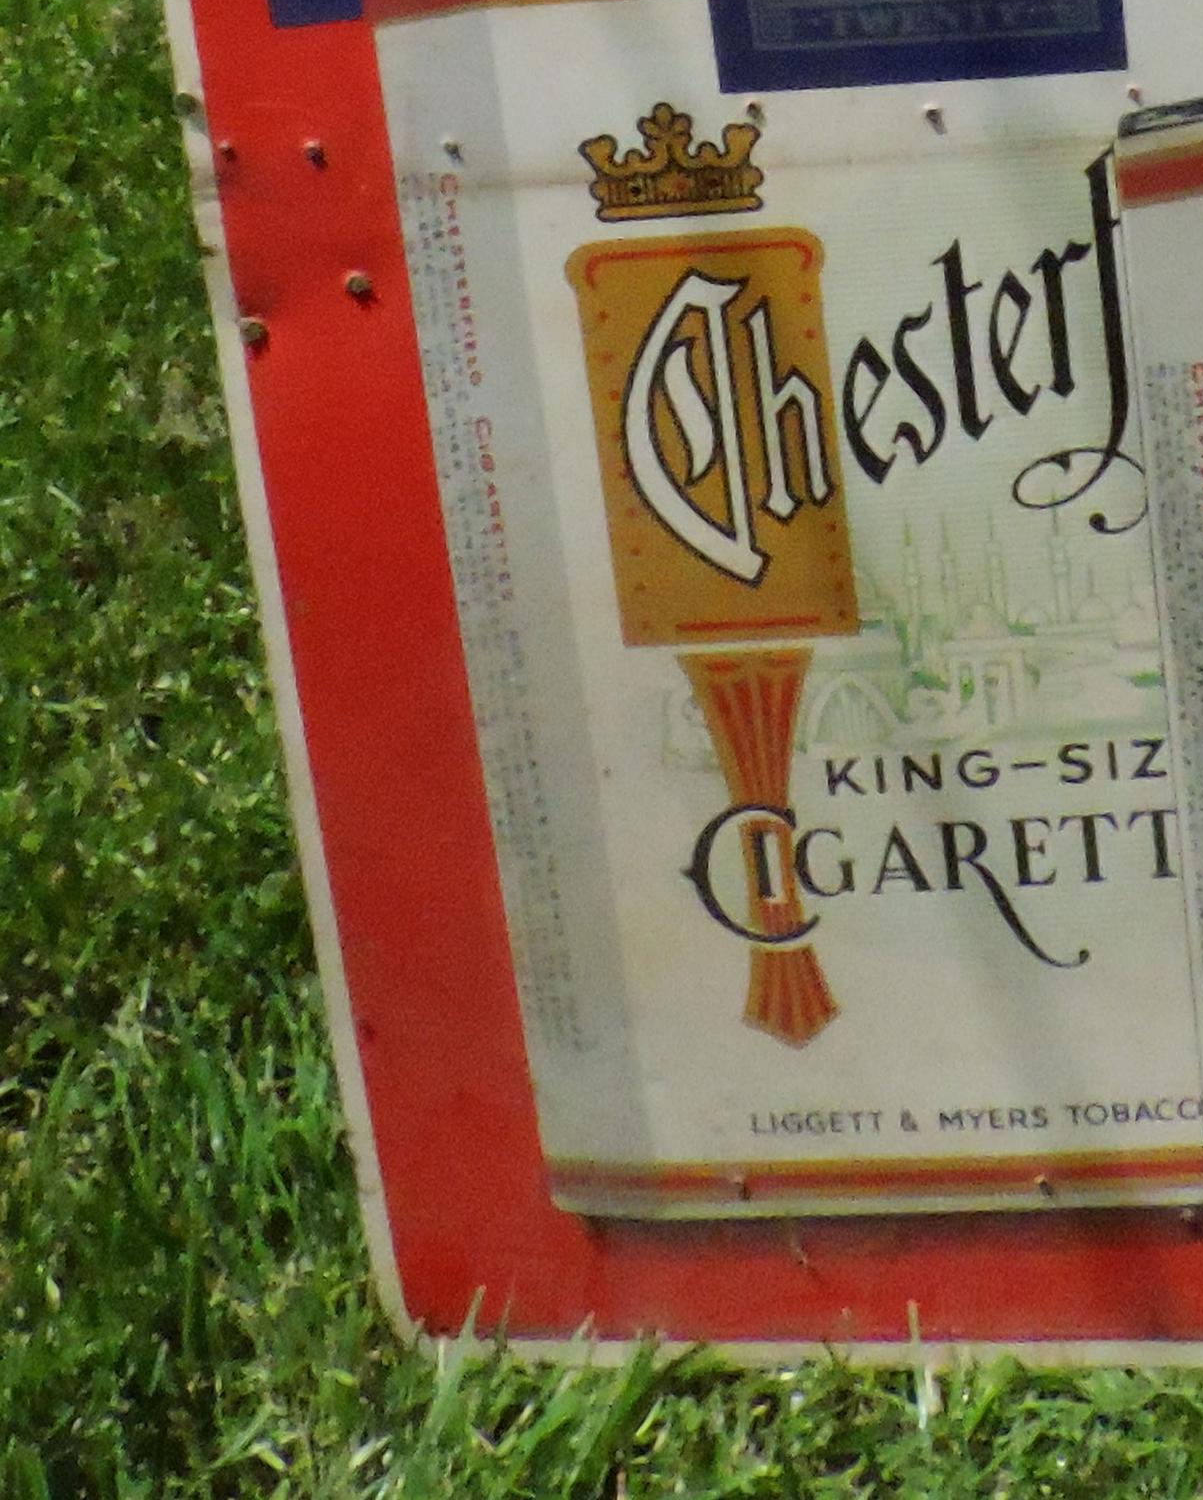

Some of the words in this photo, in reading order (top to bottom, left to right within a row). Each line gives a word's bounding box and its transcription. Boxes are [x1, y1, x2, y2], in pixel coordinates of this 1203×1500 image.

[748, 1109, 883, 1136] LIGGETT
[900, 1110, 920, 1133] &
[938, 1104, 1049, 1132] MYERS
